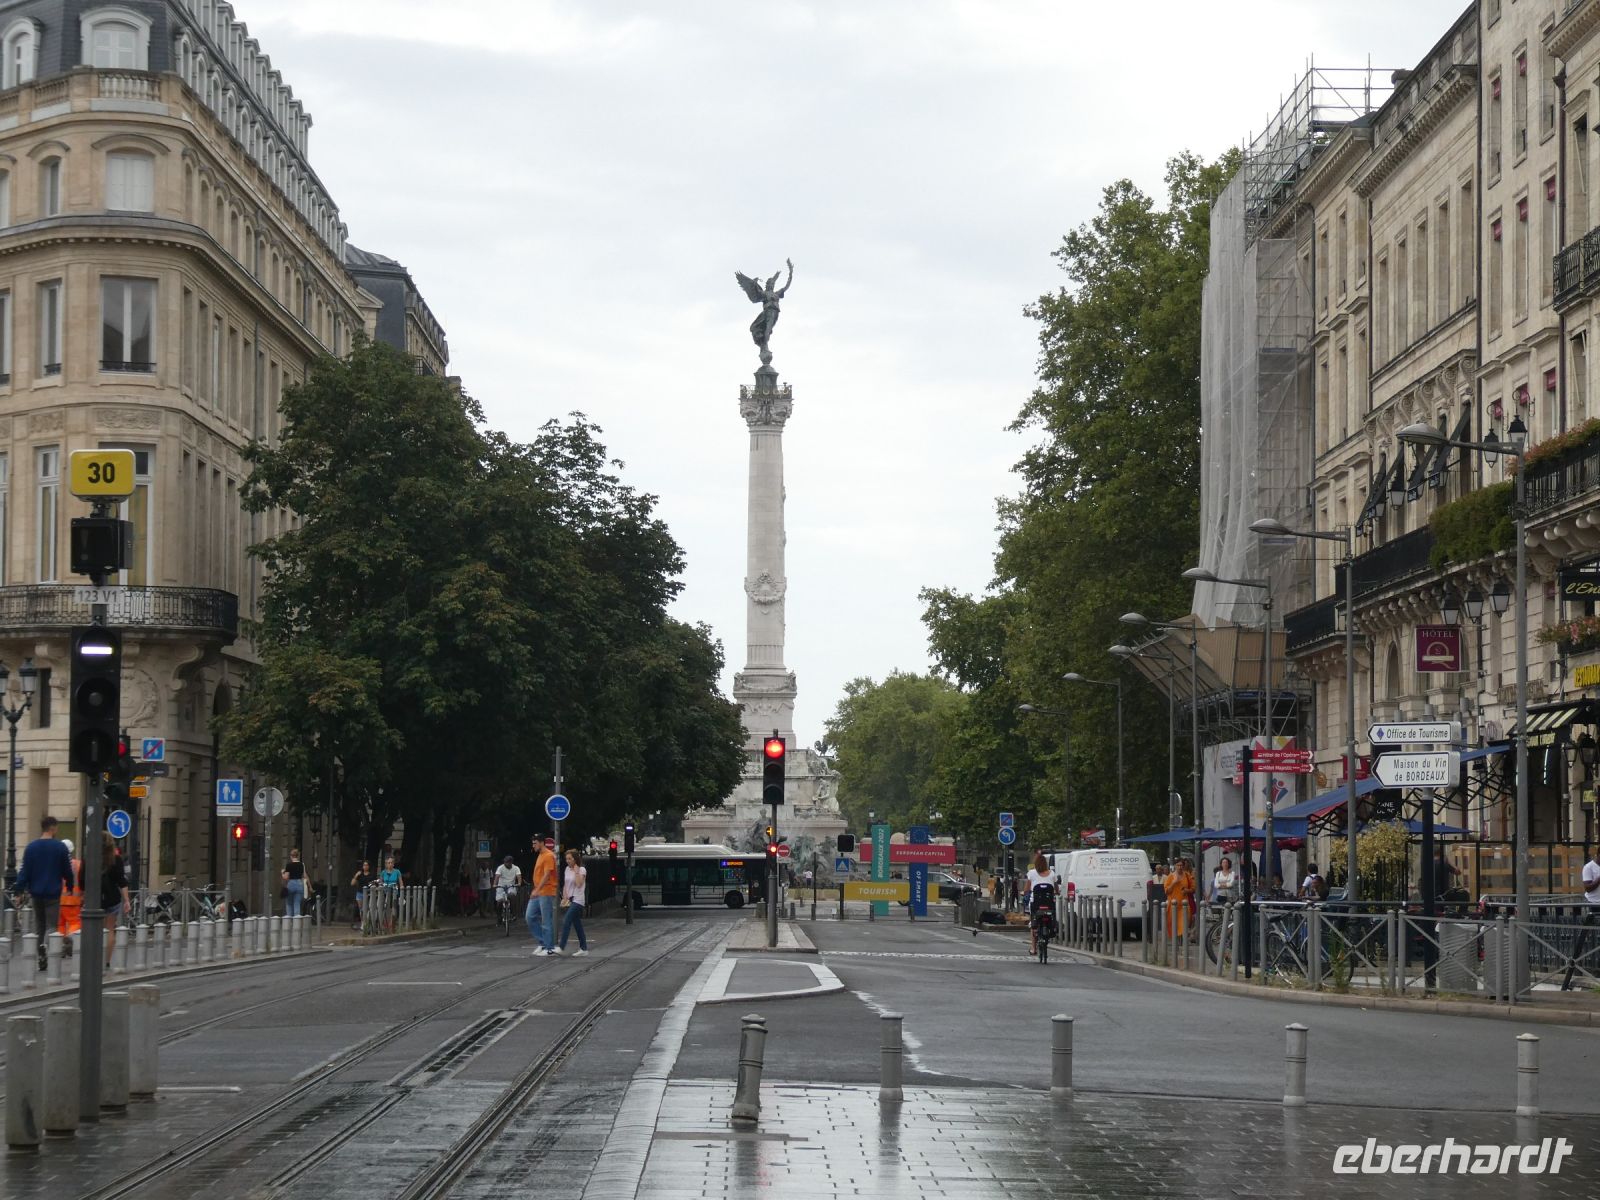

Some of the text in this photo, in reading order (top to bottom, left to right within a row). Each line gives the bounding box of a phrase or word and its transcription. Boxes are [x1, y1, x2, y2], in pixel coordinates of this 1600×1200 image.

[87, 462, 116, 484] 30
[78, 590, 99, 603] 123
[1386, 728, 1448, 739] Office de Tourisme
[1393, 757, 1447, 769] Maison du Vin
[1394, 770, 1446, 782] de BORDEAUX
[859, 887, 897, 896] TOURISM
